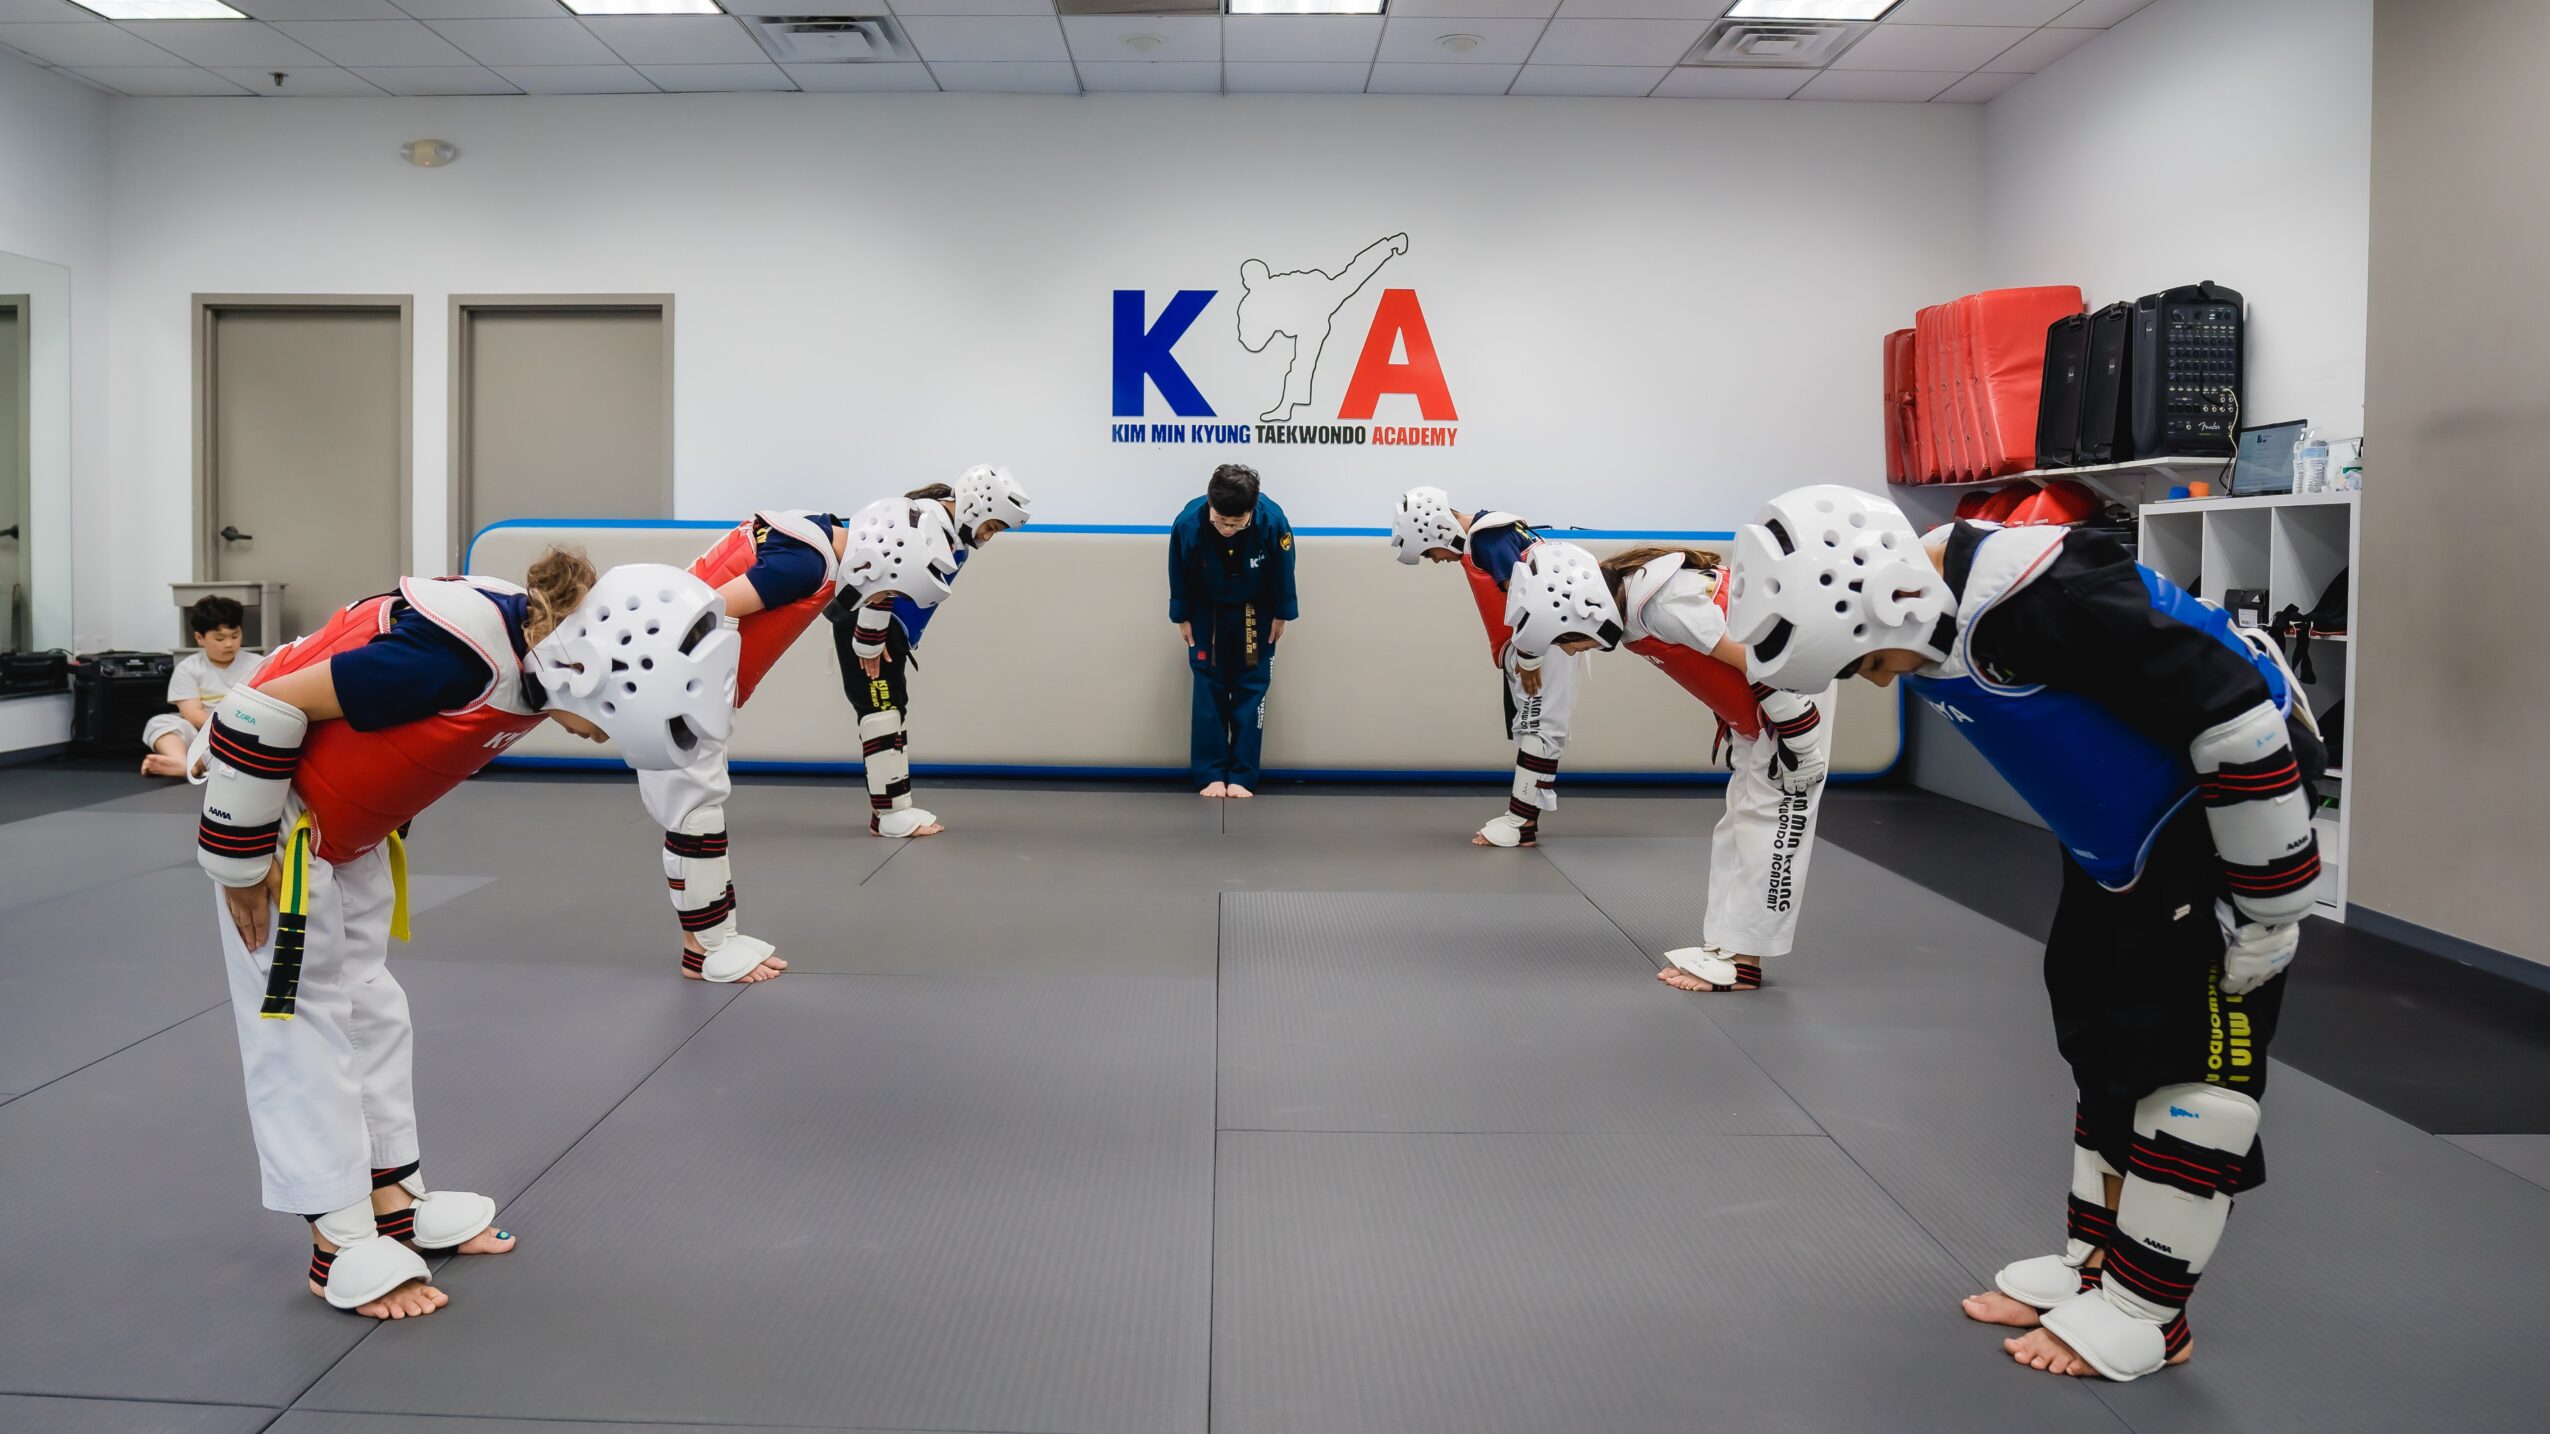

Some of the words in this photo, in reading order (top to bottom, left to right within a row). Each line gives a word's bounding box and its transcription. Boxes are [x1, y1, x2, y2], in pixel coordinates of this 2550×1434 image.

[1112, 289, 1218, 417] K
[1337, 288, 1459, 421] A
[1112, 424, 1146, 443] KIM
[1151, 424, 1185, 443] MIN
[1191, 424, 1251, 444] KYUNG
[1255, 425, 1366, 445] TAEKWONDO
[1371, 426, 1459, 446] ACADEMY
[234, 709, 256, 725] ZORA
[208, 806, 232, 821] AAMA
[1766, 853, 1784, 912] ACADEMY
[1778, 853, 1795, 912] KYUNG
[2228, 1011, 2253, 1067] MIN
[2142, 1236, 2173, 1254] AAMA
